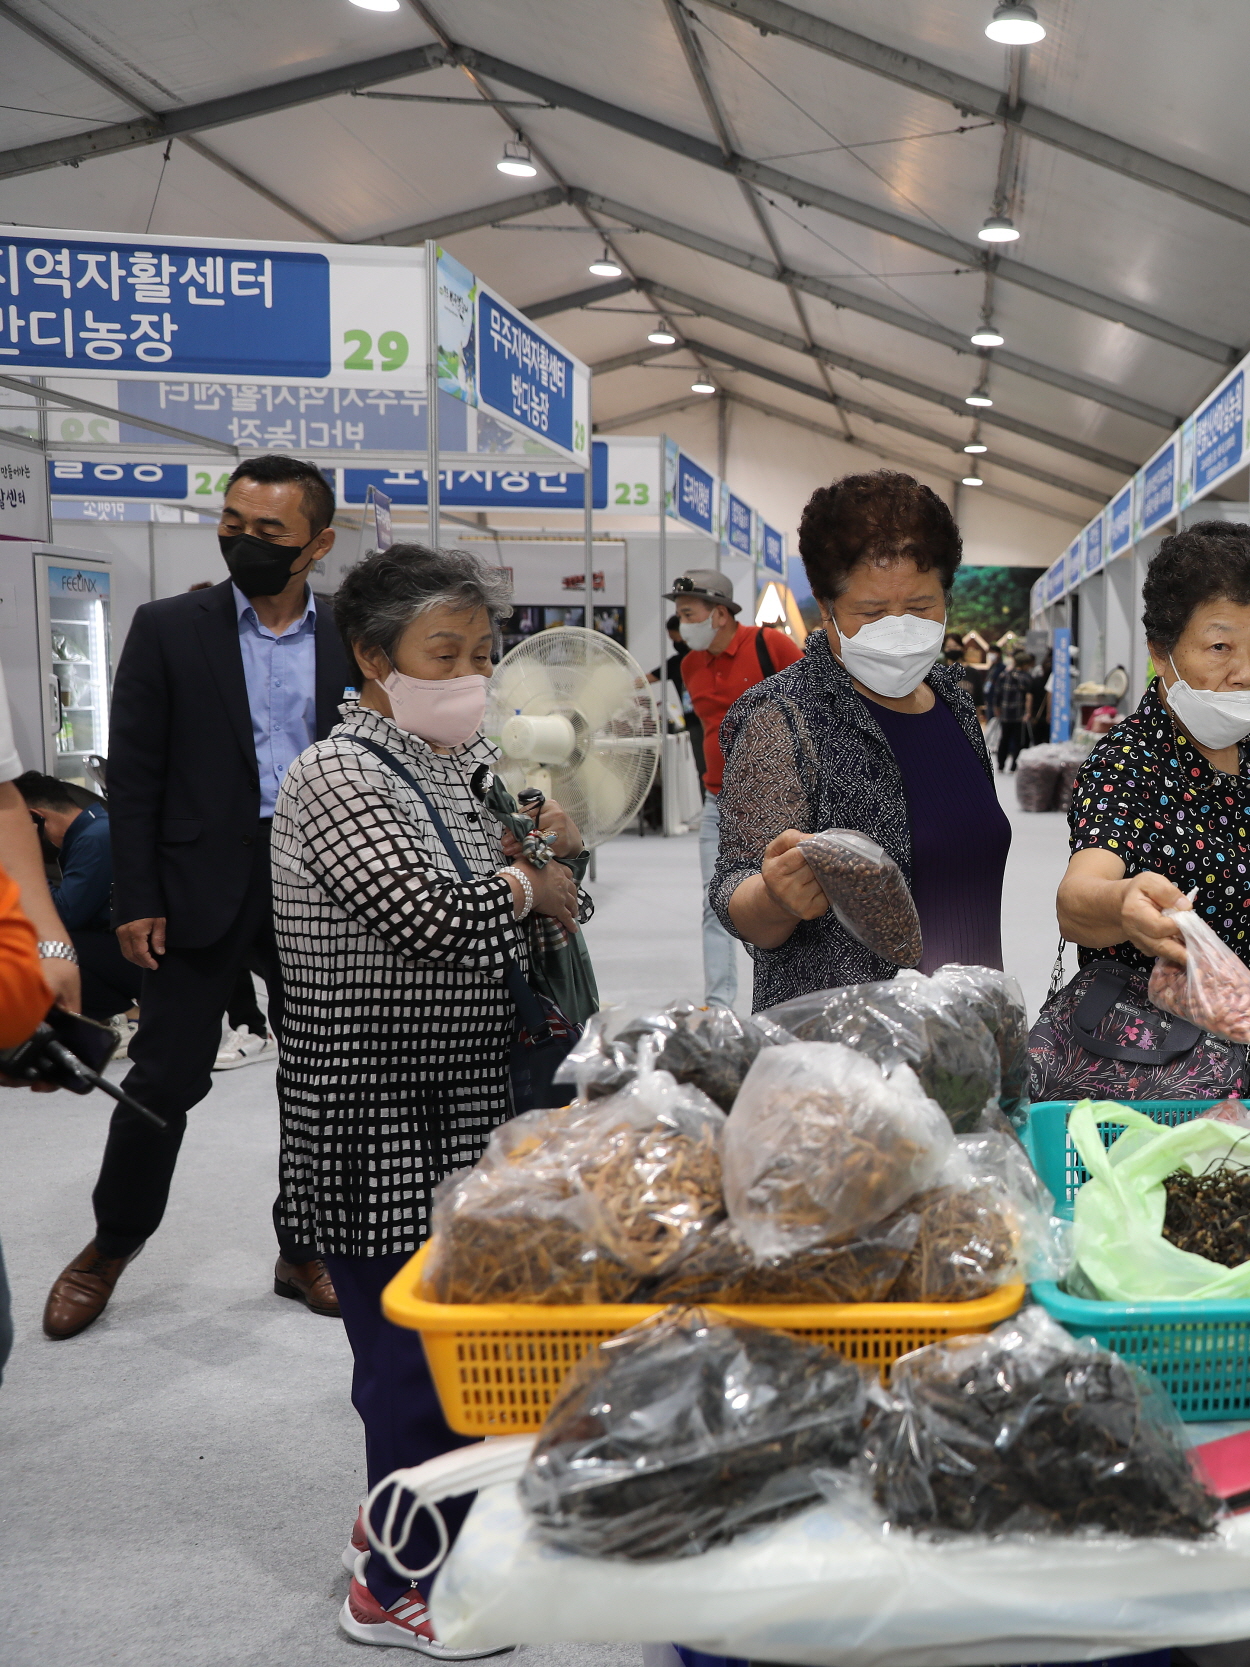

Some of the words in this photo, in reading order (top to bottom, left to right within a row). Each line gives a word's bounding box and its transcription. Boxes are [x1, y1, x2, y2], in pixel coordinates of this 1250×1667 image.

[342, 328, 410, 372] 29
[490, 307, 566, 399] 무주지역자활센터
[512, 373, 550, 432] 반디농장
[574, 420, 586, 452] 29
[614, 482, 650, 505] 23
